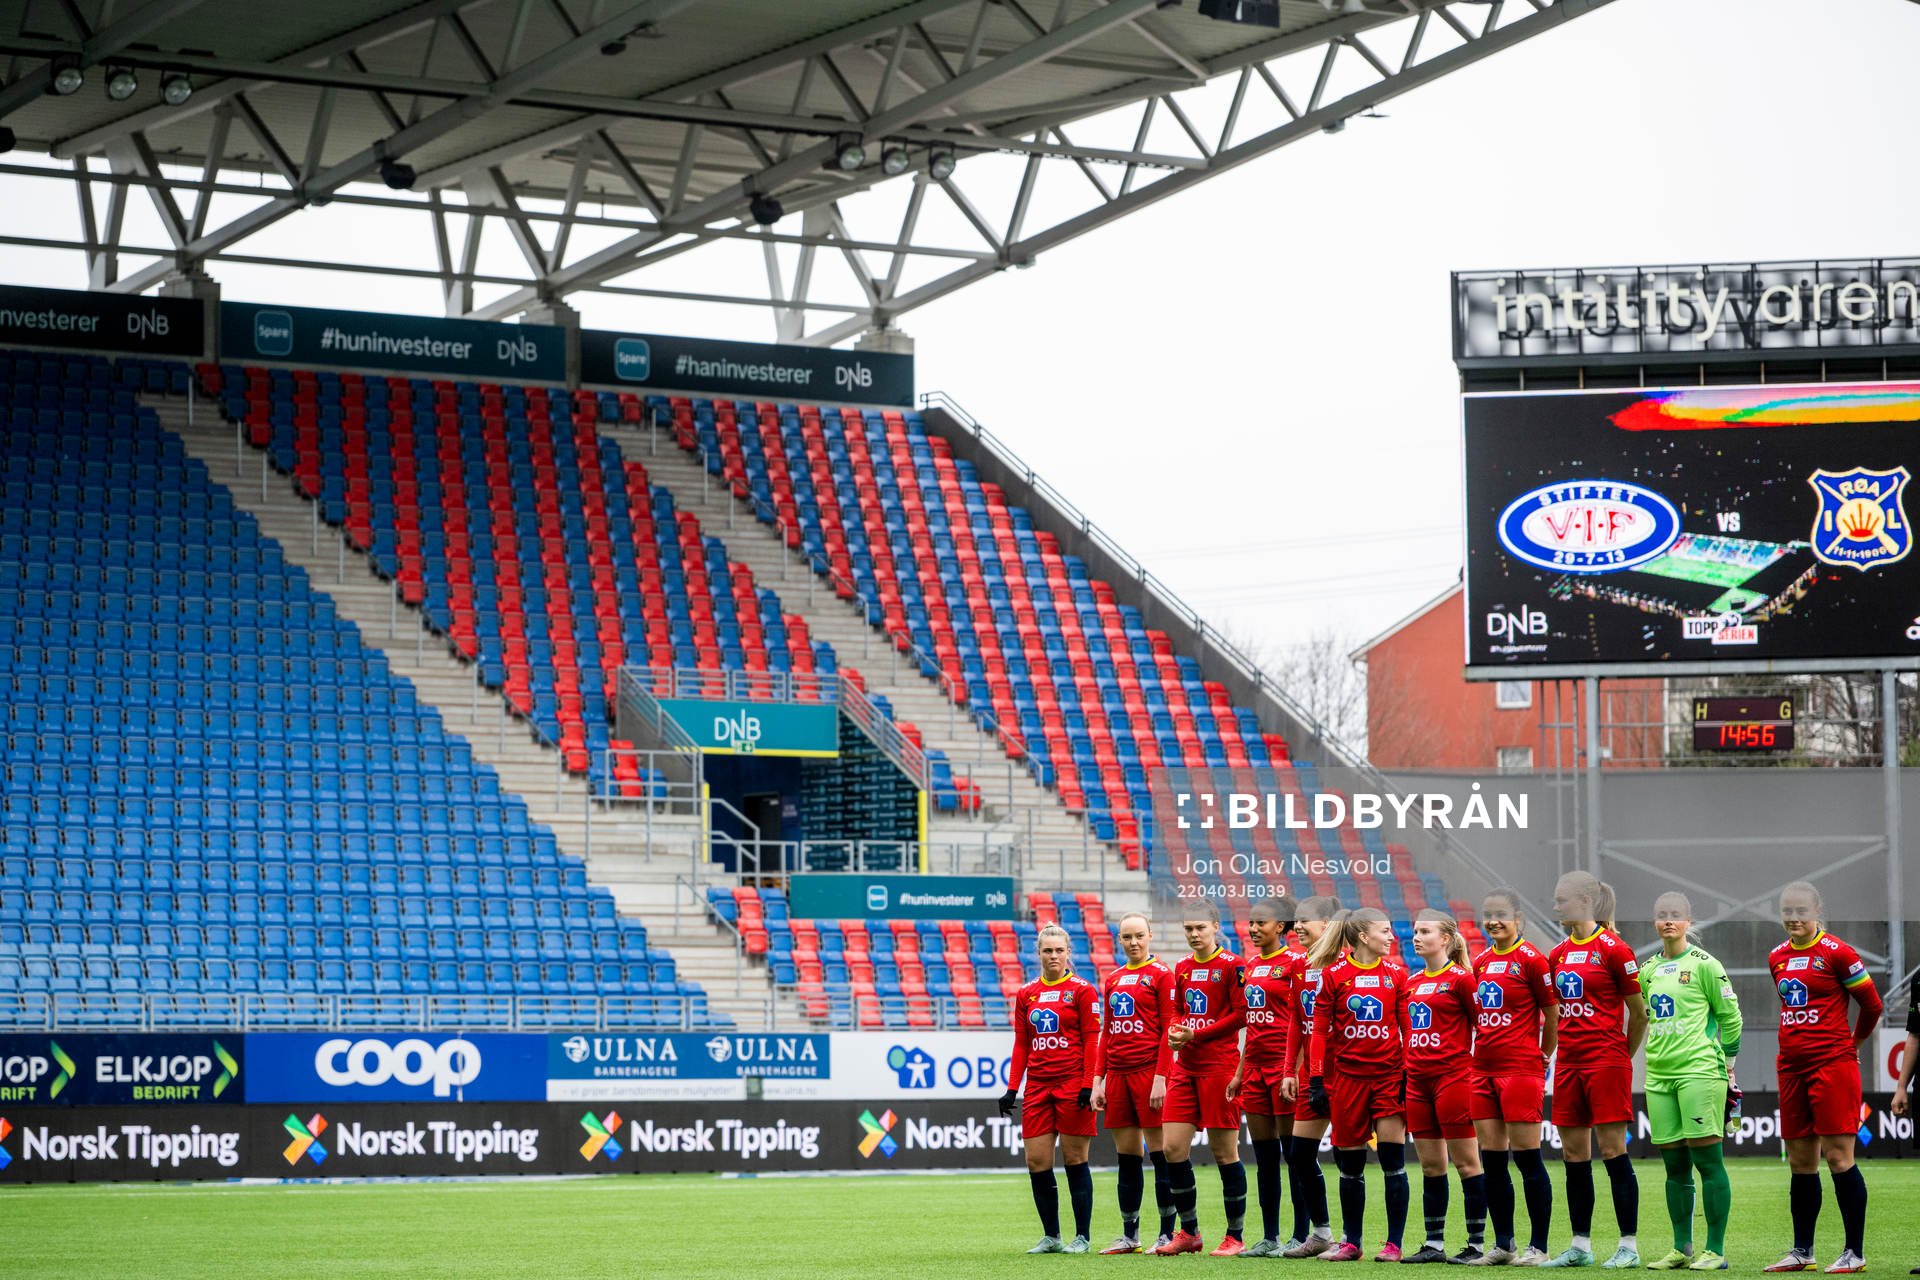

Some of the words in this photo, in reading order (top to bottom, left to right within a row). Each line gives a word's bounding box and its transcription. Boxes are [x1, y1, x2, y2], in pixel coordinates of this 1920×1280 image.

[1495, 271, 1729, 342] intility
[0, 309, 100, 332] nvesterer
[127, 308, 169, 340] DNB
[258, 325, 289, 339] Spare
[321, 327, 473, 360] #huninvesterer
[497, 336, 538, 366] DNB
[618, 351, 647, 365] Spare
[675, 355, 813, 384] #haninvesterer
[835, 361, 872, 392] DNB
[1538, 487, 1638, 506] STIFTET
[1487, 603, 1548, 643] DNB
[1688, 621, 1718, 635] TOPP
[1718, 628, 1754, 640] SERIEN
[1695, 703, 1708, 720] H
[1780, 701, 1791, 719] G
[714, 709, 761, 747] DNB
[1720, 724, 1775, 747] 14:56
[985, 891, 1007, 908] DNB
[1690, 950, 1709, 960] evo
[1821, 937, 1839, 950] evo
[1559, 1002, 1595, 1017] OBOS
[1032, 1036, 1069, 1051] OBOS
[1345, 1025, 1390, 1039] OBOS
[1409, 1032, 1441, 1047] BOS
[594, 1038, 678, 1061] ULNA
[736, 1038, 818, 1061] ULNA
[314, 1039, 482, 1096] coop
[594, 1066, 677, 1077] BARNEHAGENE
[736, 1066, 817, 1077] BARNEHAGENE
[133, 1086, 200, 1100] BEDRIFT
[337, 1122, 426, 1156] Norsk
[428, 1120, 539, 1163] Tipping
[631, 1120, 714, 1153] Norsk
[715, 1119, 820, 1158] Tipping
[905, 1117, 986, 1149] Norsk
[23, 1126, 118, 1160] Norsk
[121, 1124, 239, 1167] Tipping
